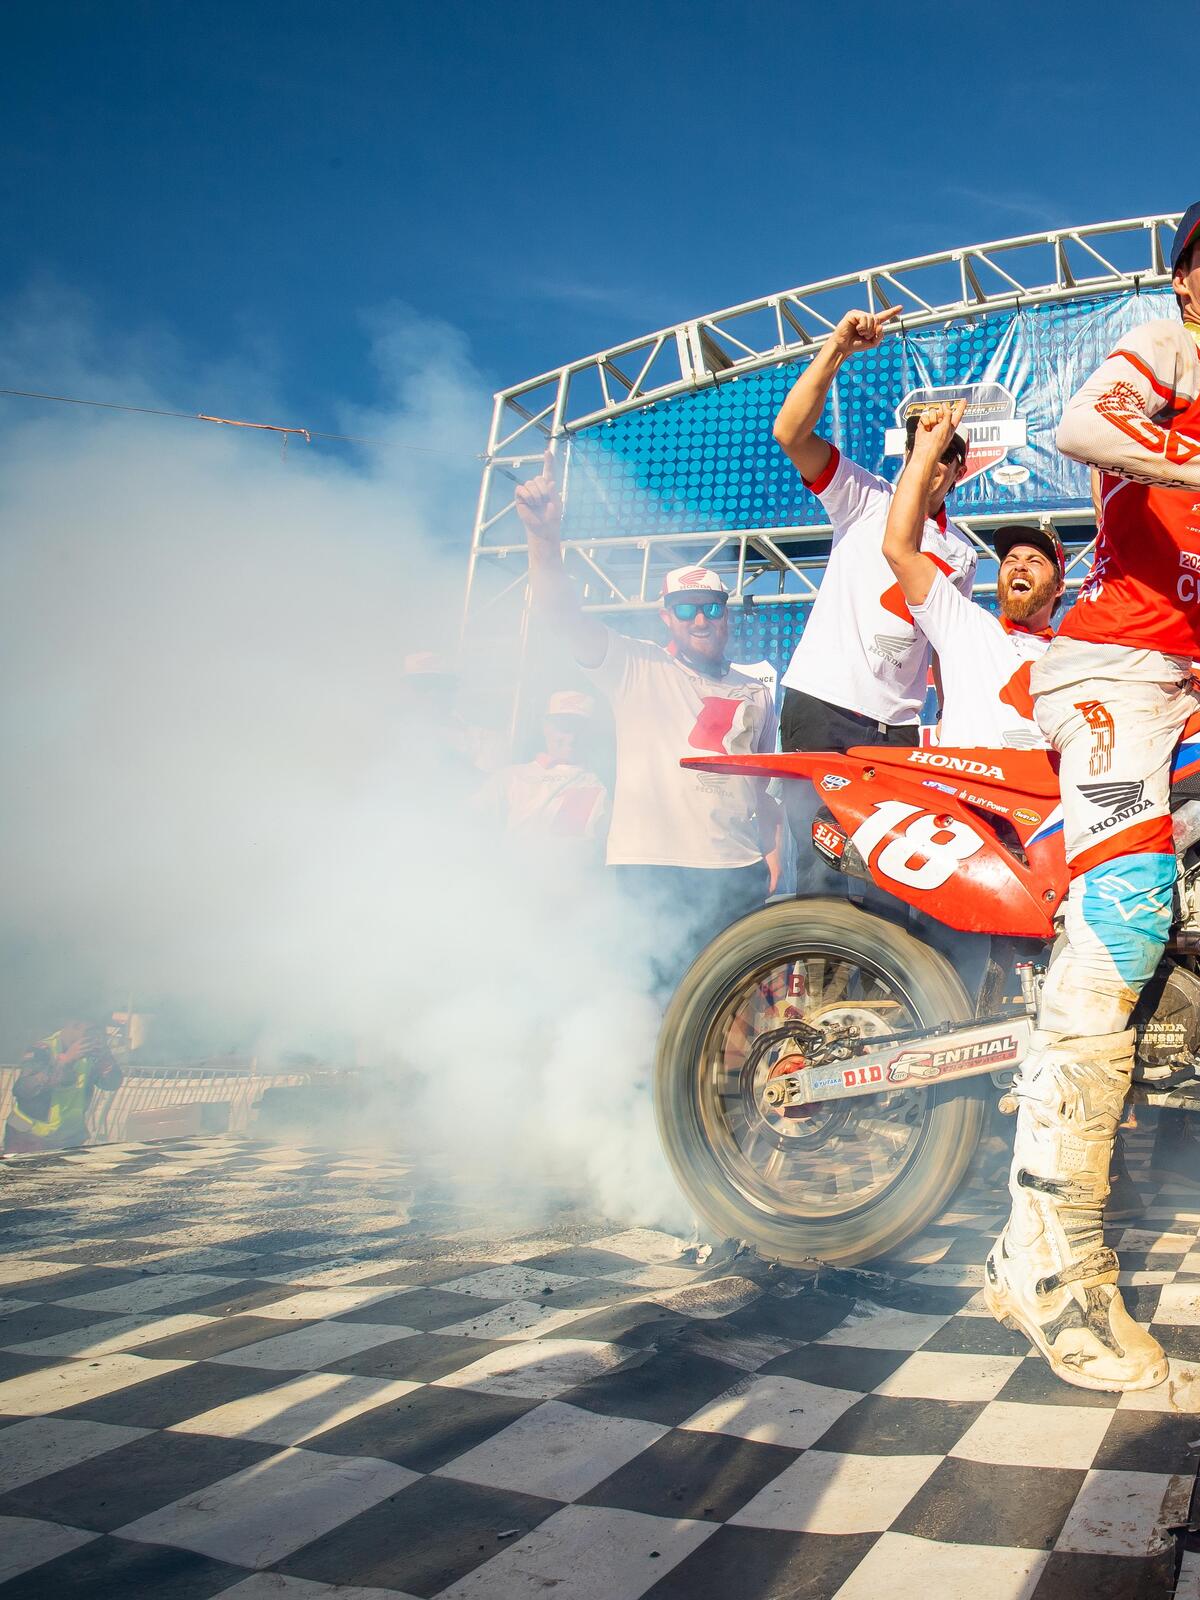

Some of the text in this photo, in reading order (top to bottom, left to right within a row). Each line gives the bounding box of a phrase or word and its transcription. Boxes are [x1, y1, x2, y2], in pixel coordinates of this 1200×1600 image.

[868, 644, 903, 669] HONDA
[907, 751, 1006, 781] HONDA
[986, 799, 1010, 814] Power
[1029, 815, 1039, 823] Air
[1088, 799, 1155, 835] HONDA
[850, 800, 985, 891] 18
